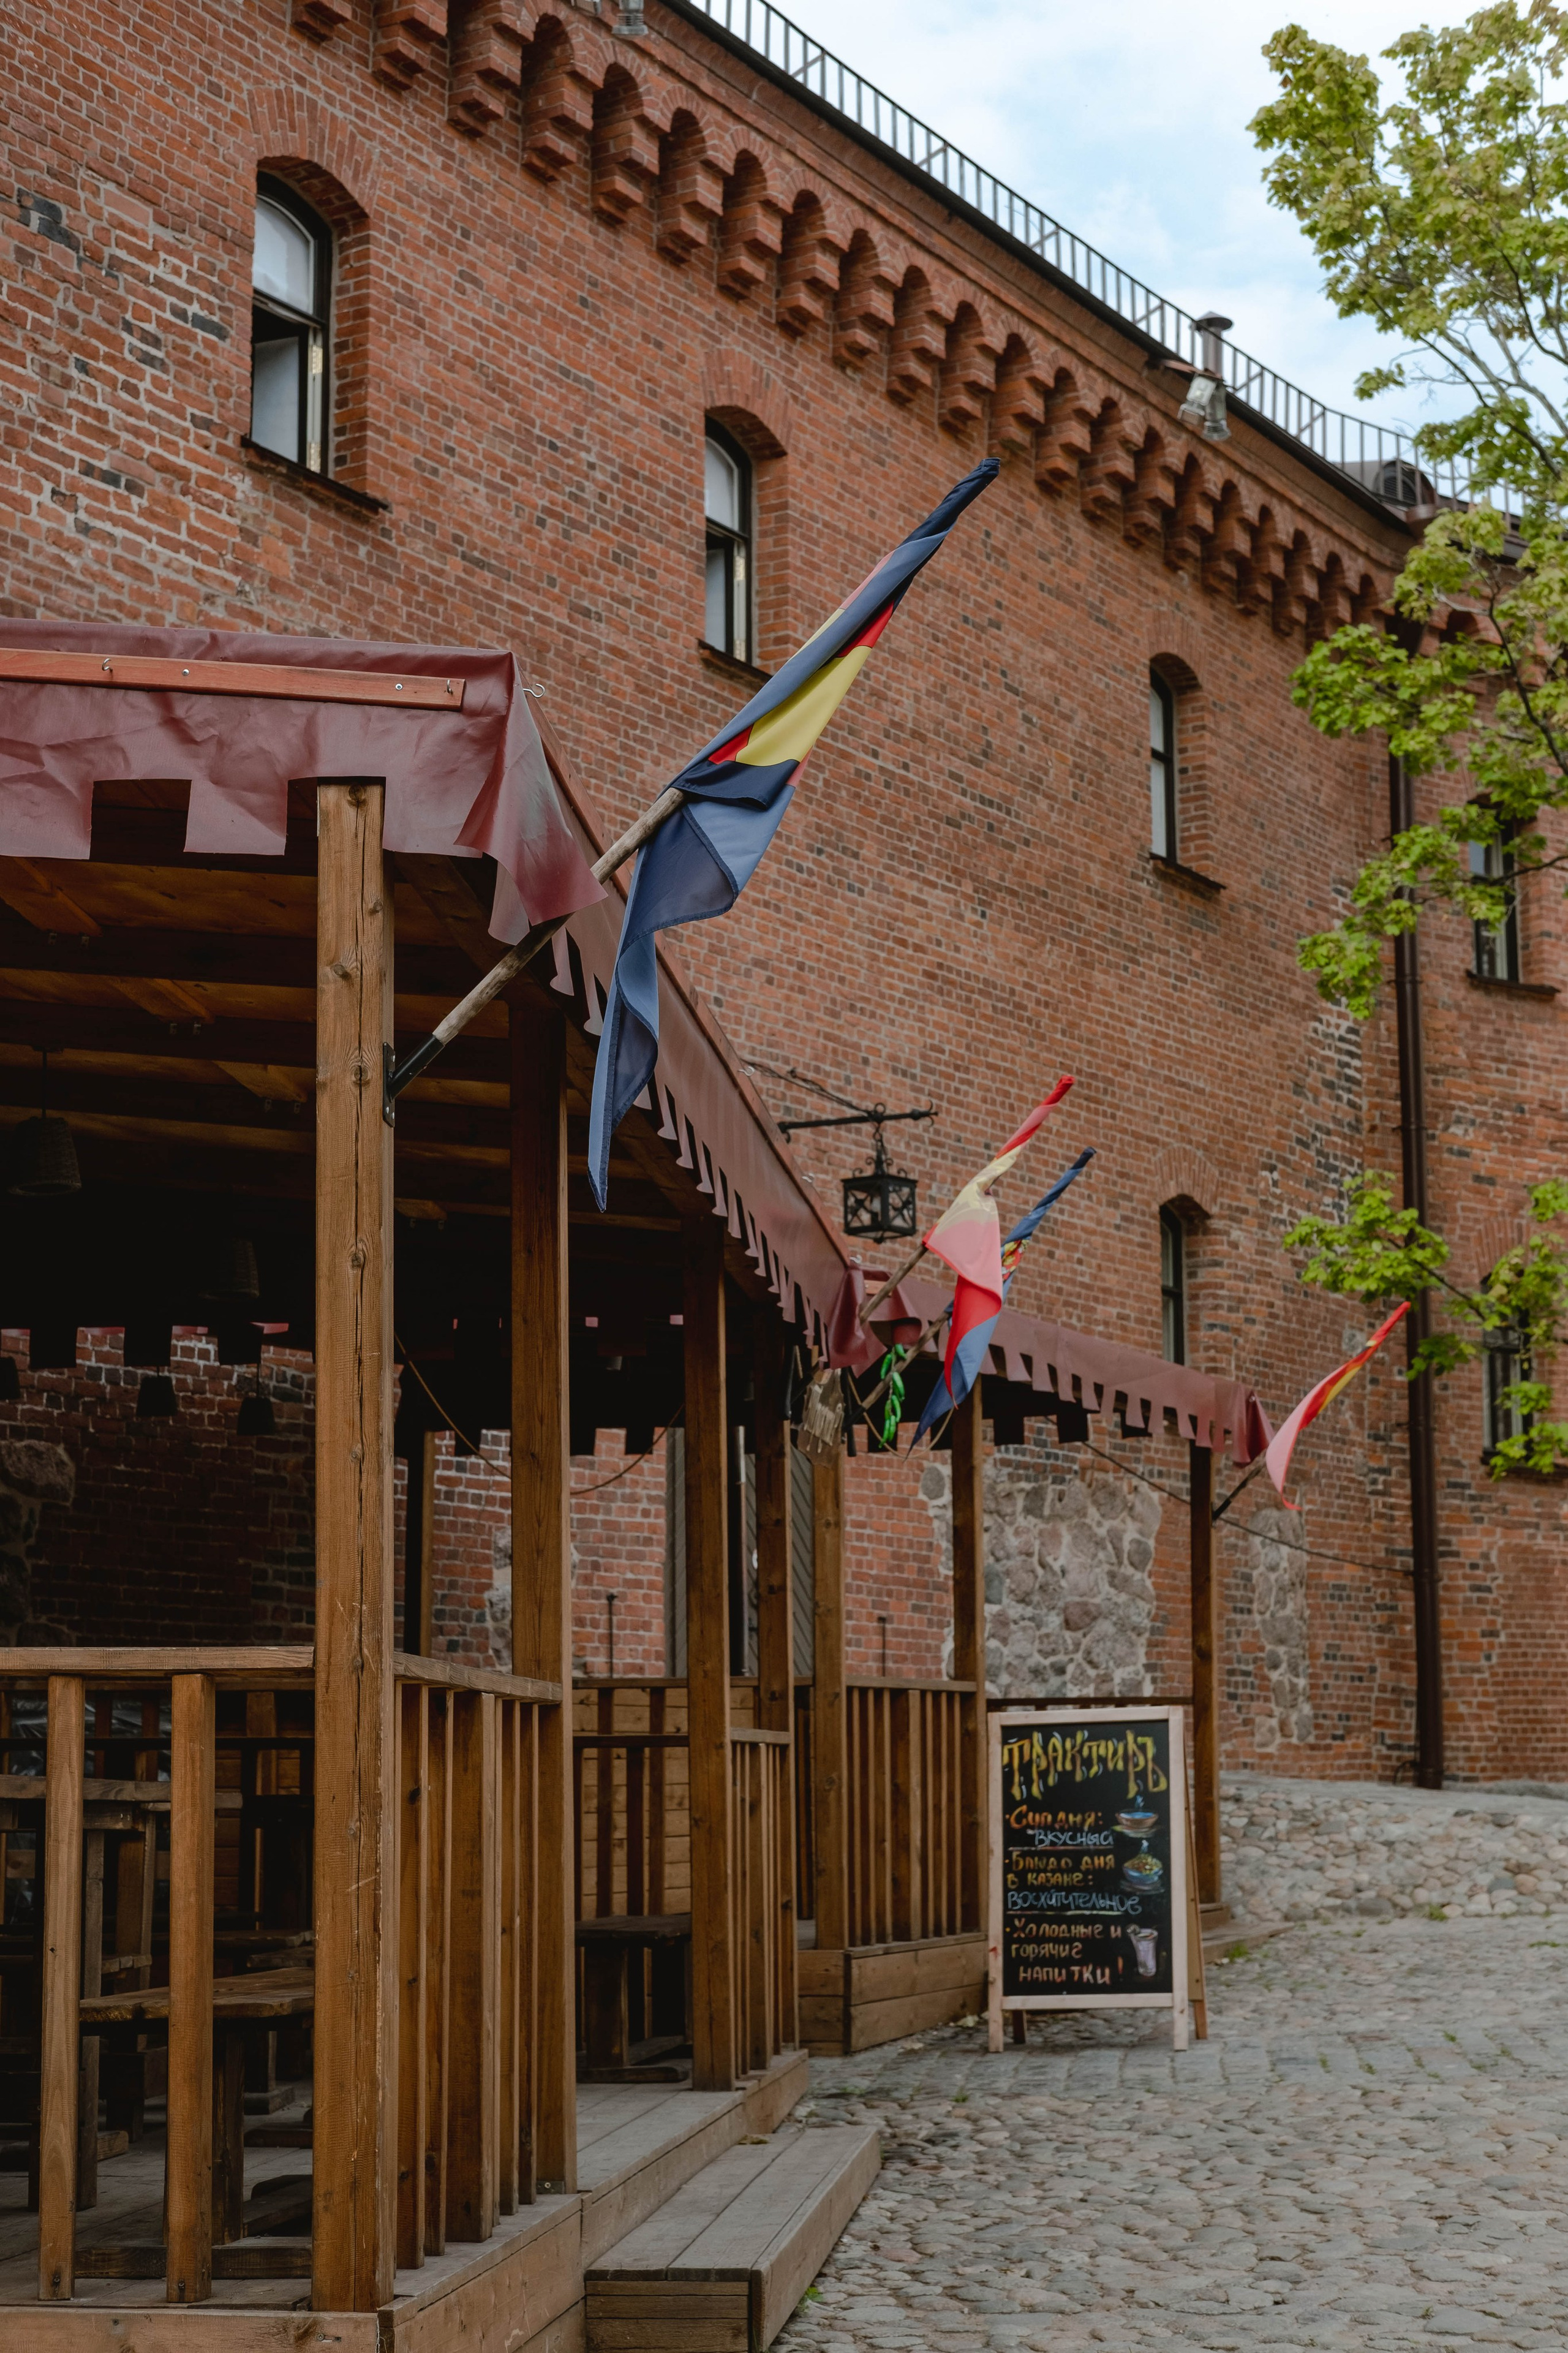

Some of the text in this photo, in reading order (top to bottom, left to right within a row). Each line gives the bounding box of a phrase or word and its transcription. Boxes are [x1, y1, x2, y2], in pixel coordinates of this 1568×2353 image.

[1080, 1854, 1115, 1871] дня
[1012, 1917, 1122, 1939] Холодные и
[1011, 1941, 1084, 1962] горячие
